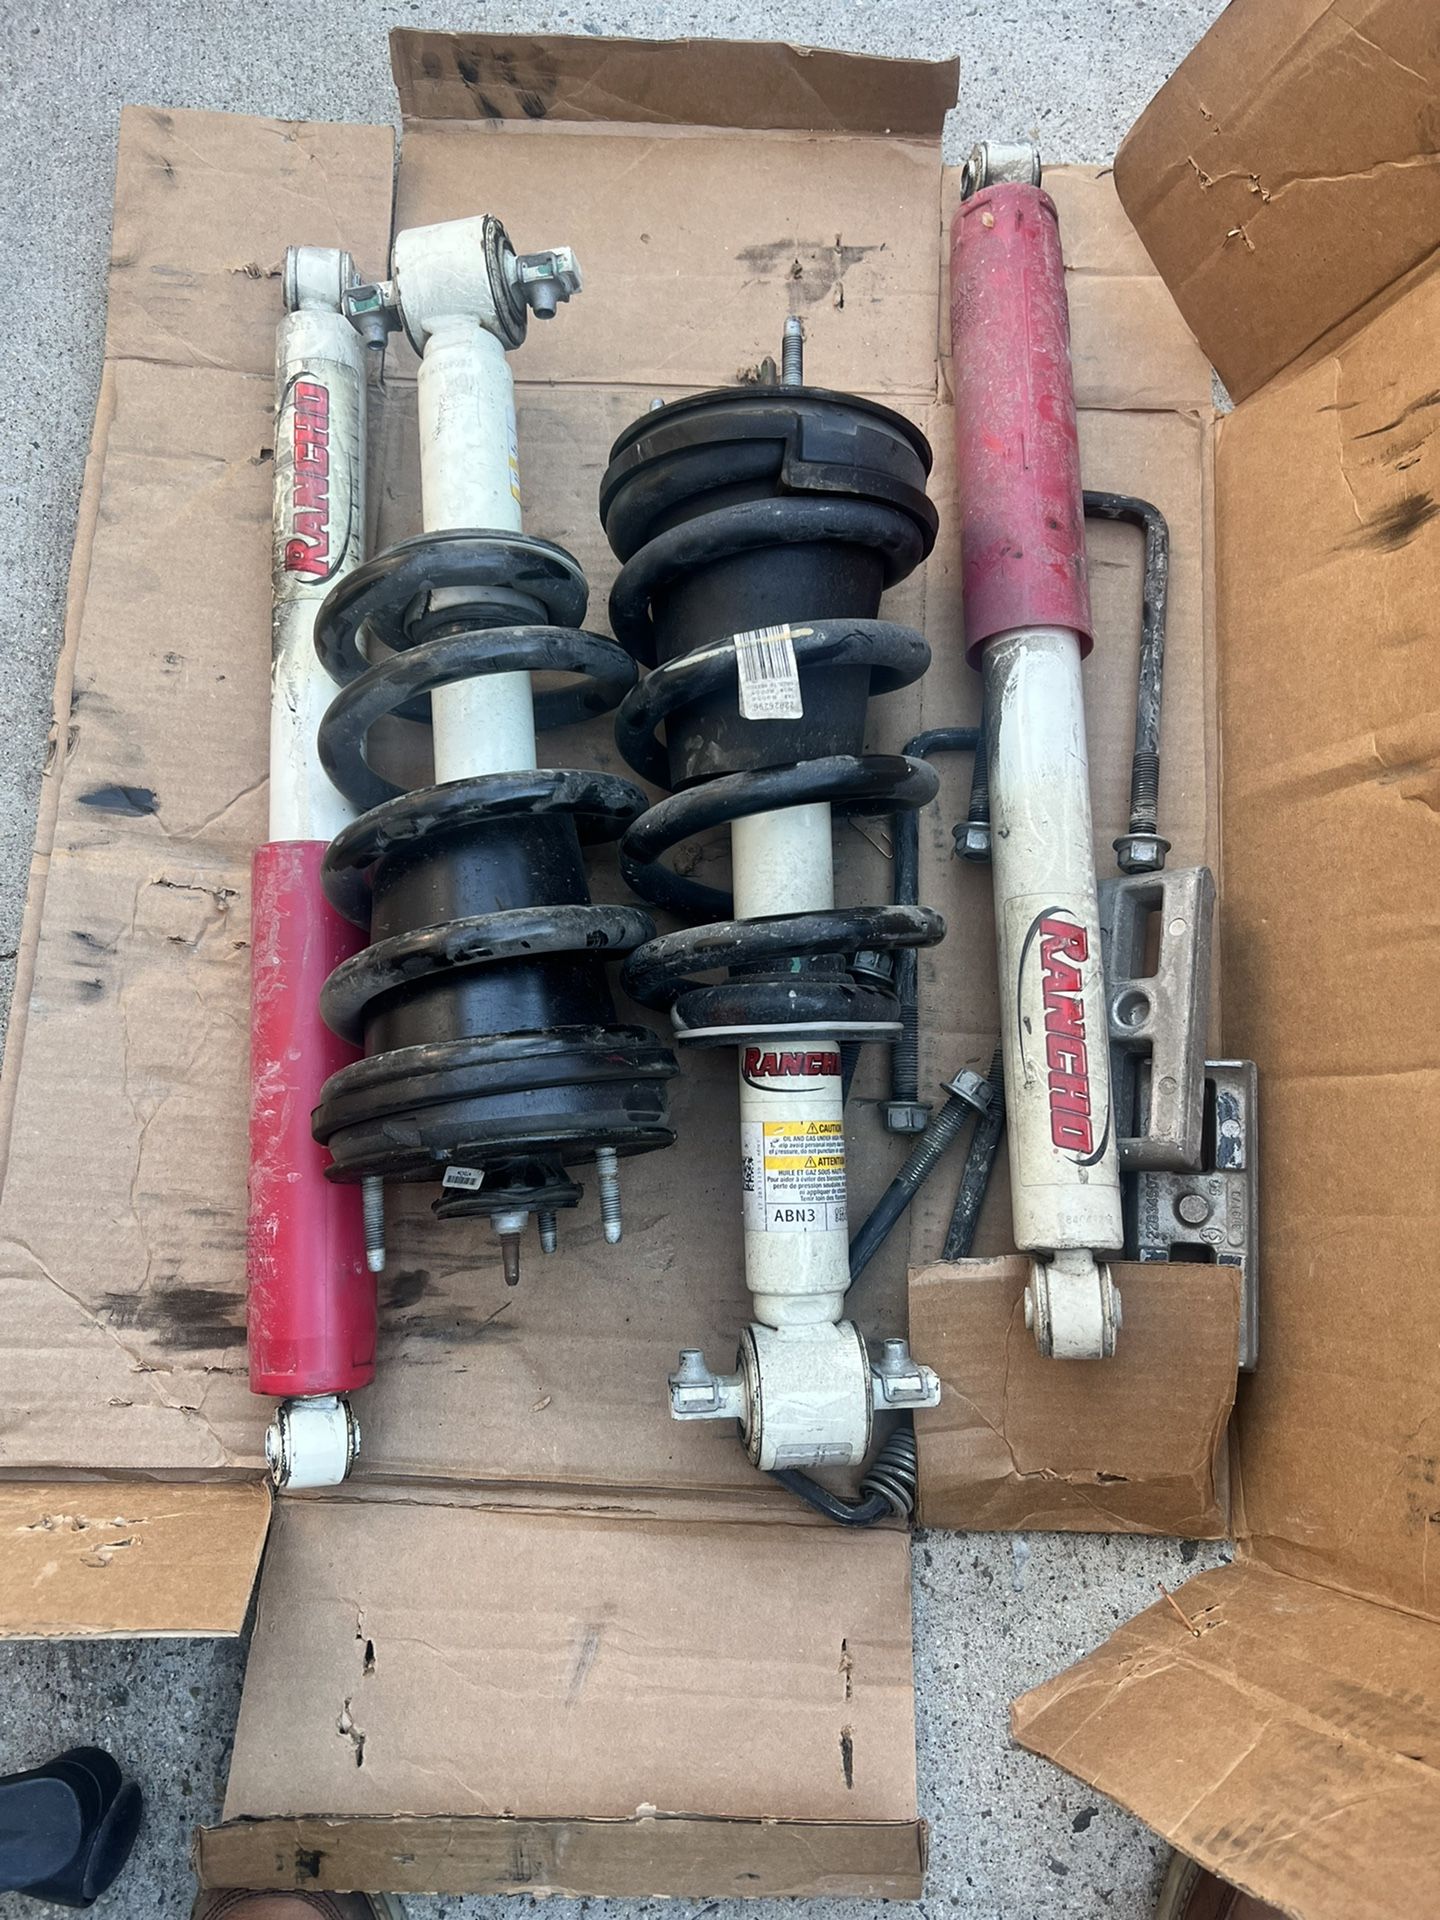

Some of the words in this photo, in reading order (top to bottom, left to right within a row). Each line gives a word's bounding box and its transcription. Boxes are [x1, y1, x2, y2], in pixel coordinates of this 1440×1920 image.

[285, 381, 330, 577] RANCHO
[1039, 917, 1094, 1155] RANCHO
[743, 1047, 841, 1077] RANCH
[819, 1123, 842, 1133] CAUTIO
[774, 1209, 816, 1222] ABN3
